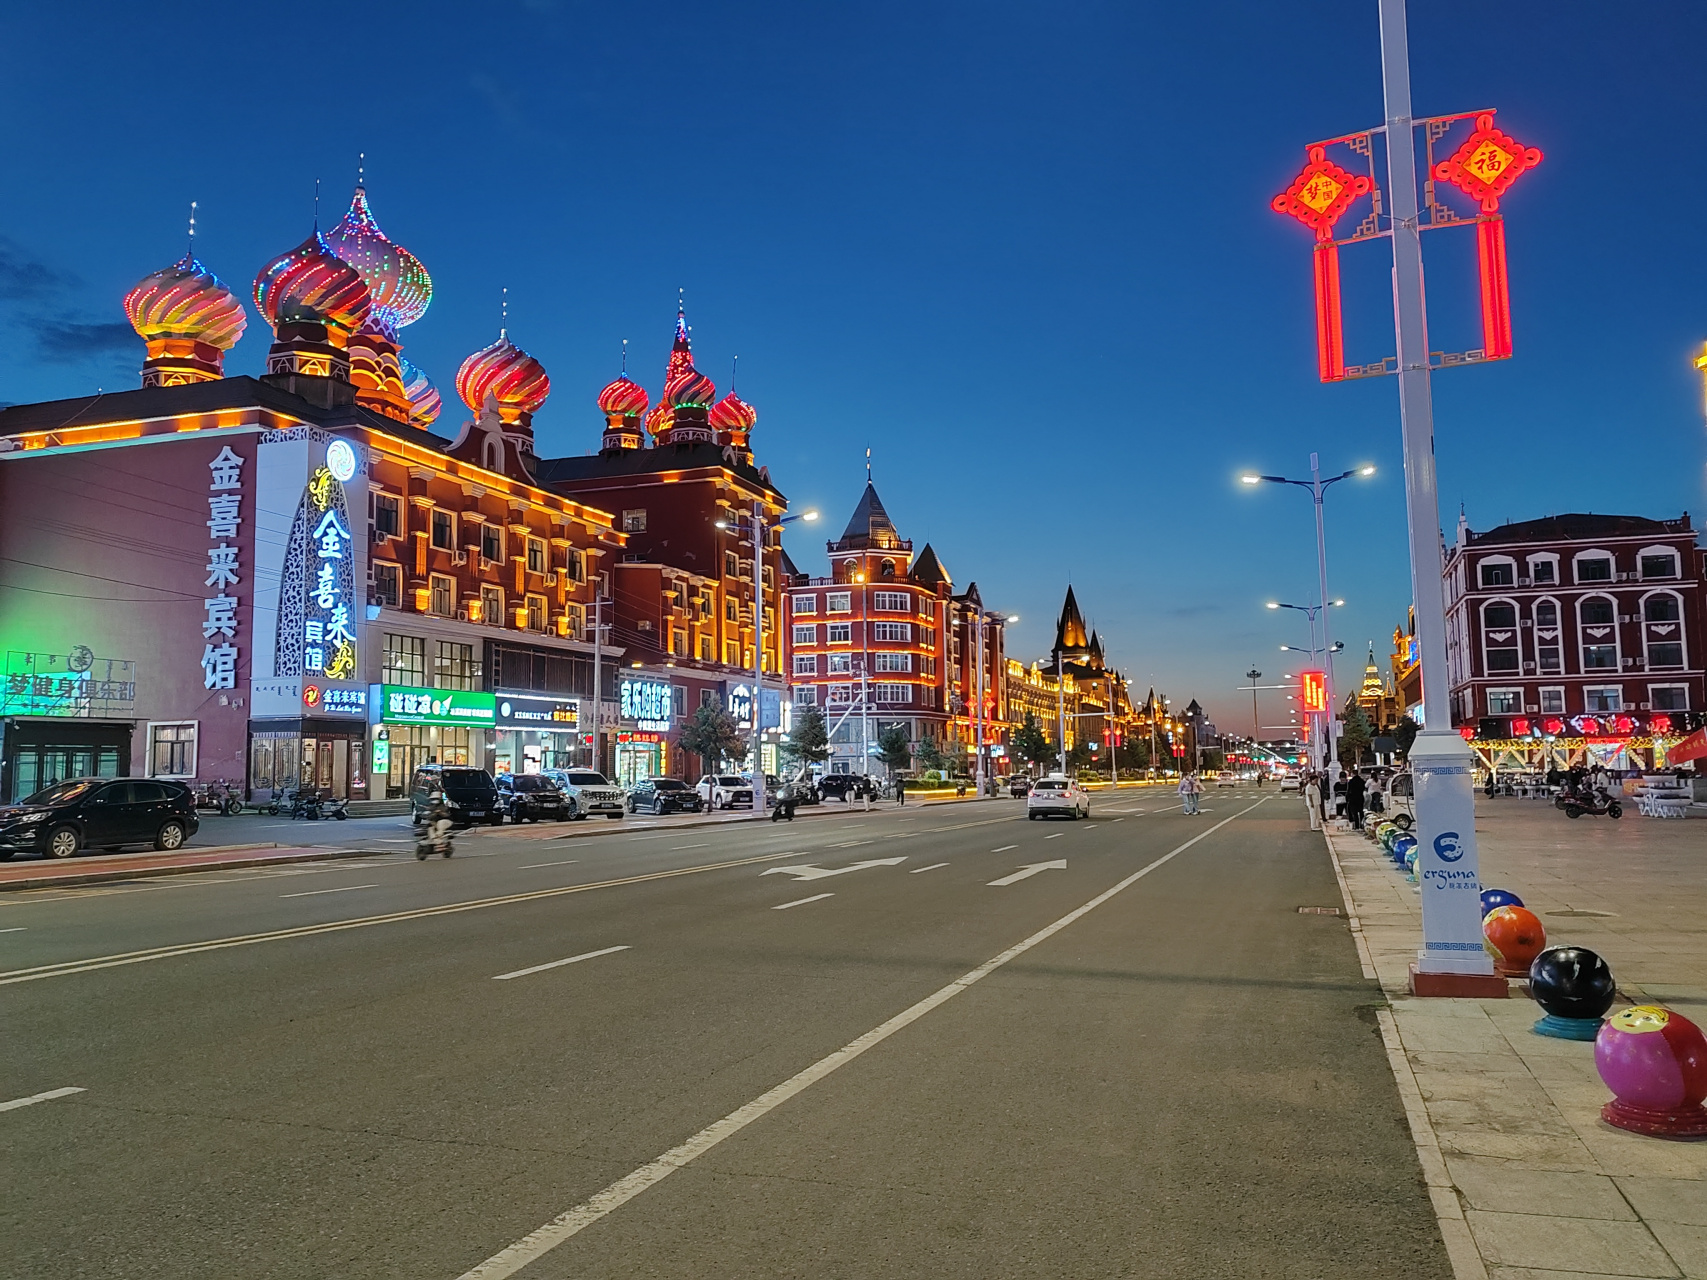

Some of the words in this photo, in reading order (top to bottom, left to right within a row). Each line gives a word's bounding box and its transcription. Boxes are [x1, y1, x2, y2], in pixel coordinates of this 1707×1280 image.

[1473, 151, 1502, 174] 福
[1305, 184, 1321, 204] 梦
[1321, 179, 1334, 202] 中国
[201, 445, 245, 690] 金喜来宾馆
[309, 509, 357, 649] 金喜来
[305, 620, 324, 671] 宾馆
[323, 689, 366, 704] 金喜来宾馆
[621, 680, 672, 720] 家乐购超市
[1424, 870, 1475, 890] erguna
